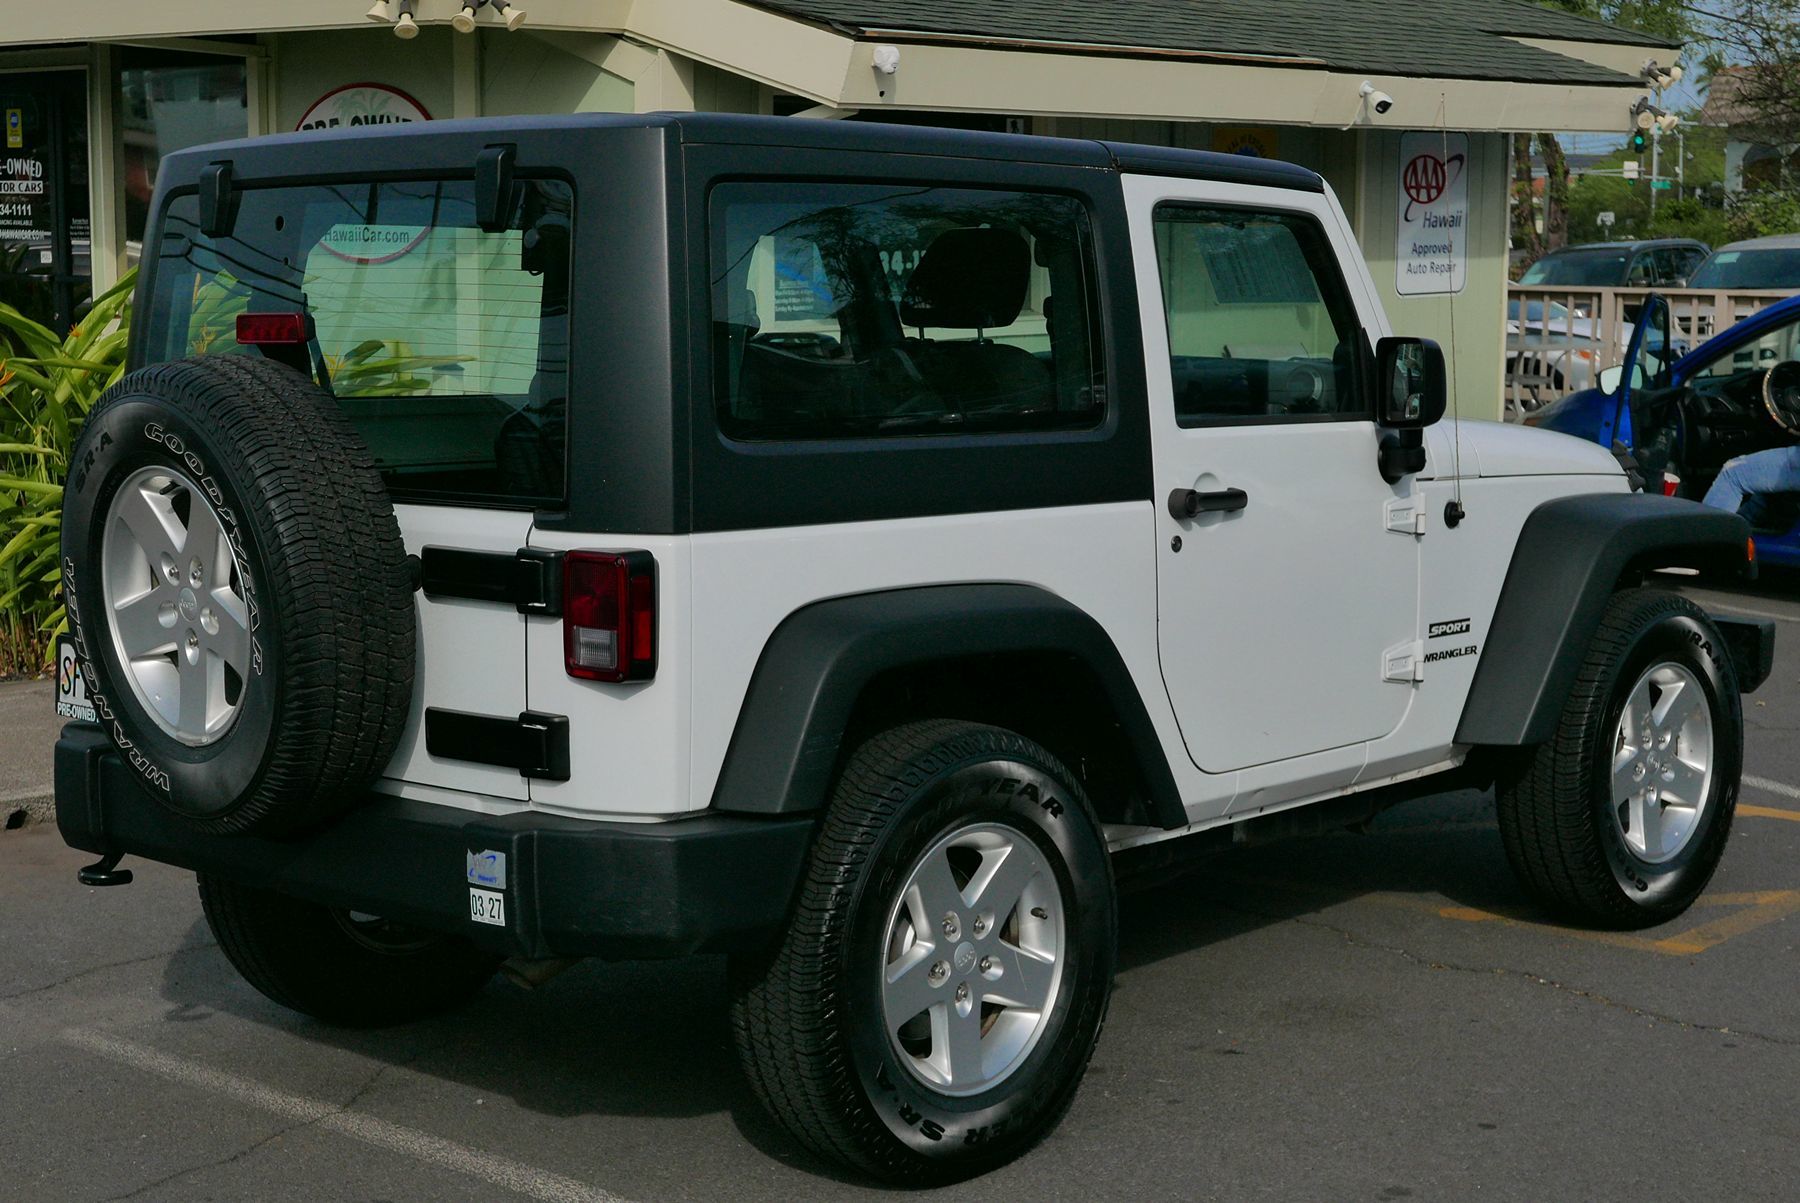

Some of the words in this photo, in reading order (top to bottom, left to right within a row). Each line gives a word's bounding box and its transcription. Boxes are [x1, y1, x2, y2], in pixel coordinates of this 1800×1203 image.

[18, 182, 42, 193] CARS
[1408, 156, 1443, 203] AAA
[1422, 210, 1463, 229] Hawaii
[1411, 243, 1452, 258] Approved
[1406, 262, 1427, 275] Auto
[1430, 262, 1456, 276] Repair
[1429, 619, 1471, 638] SPORT
[64, 556, 170, 792] WRANGLER
[57, 701, 96, 723] PRE-OWNED
[471, 894, 485, 917] 03
[488, 897, 502, 920] 27
